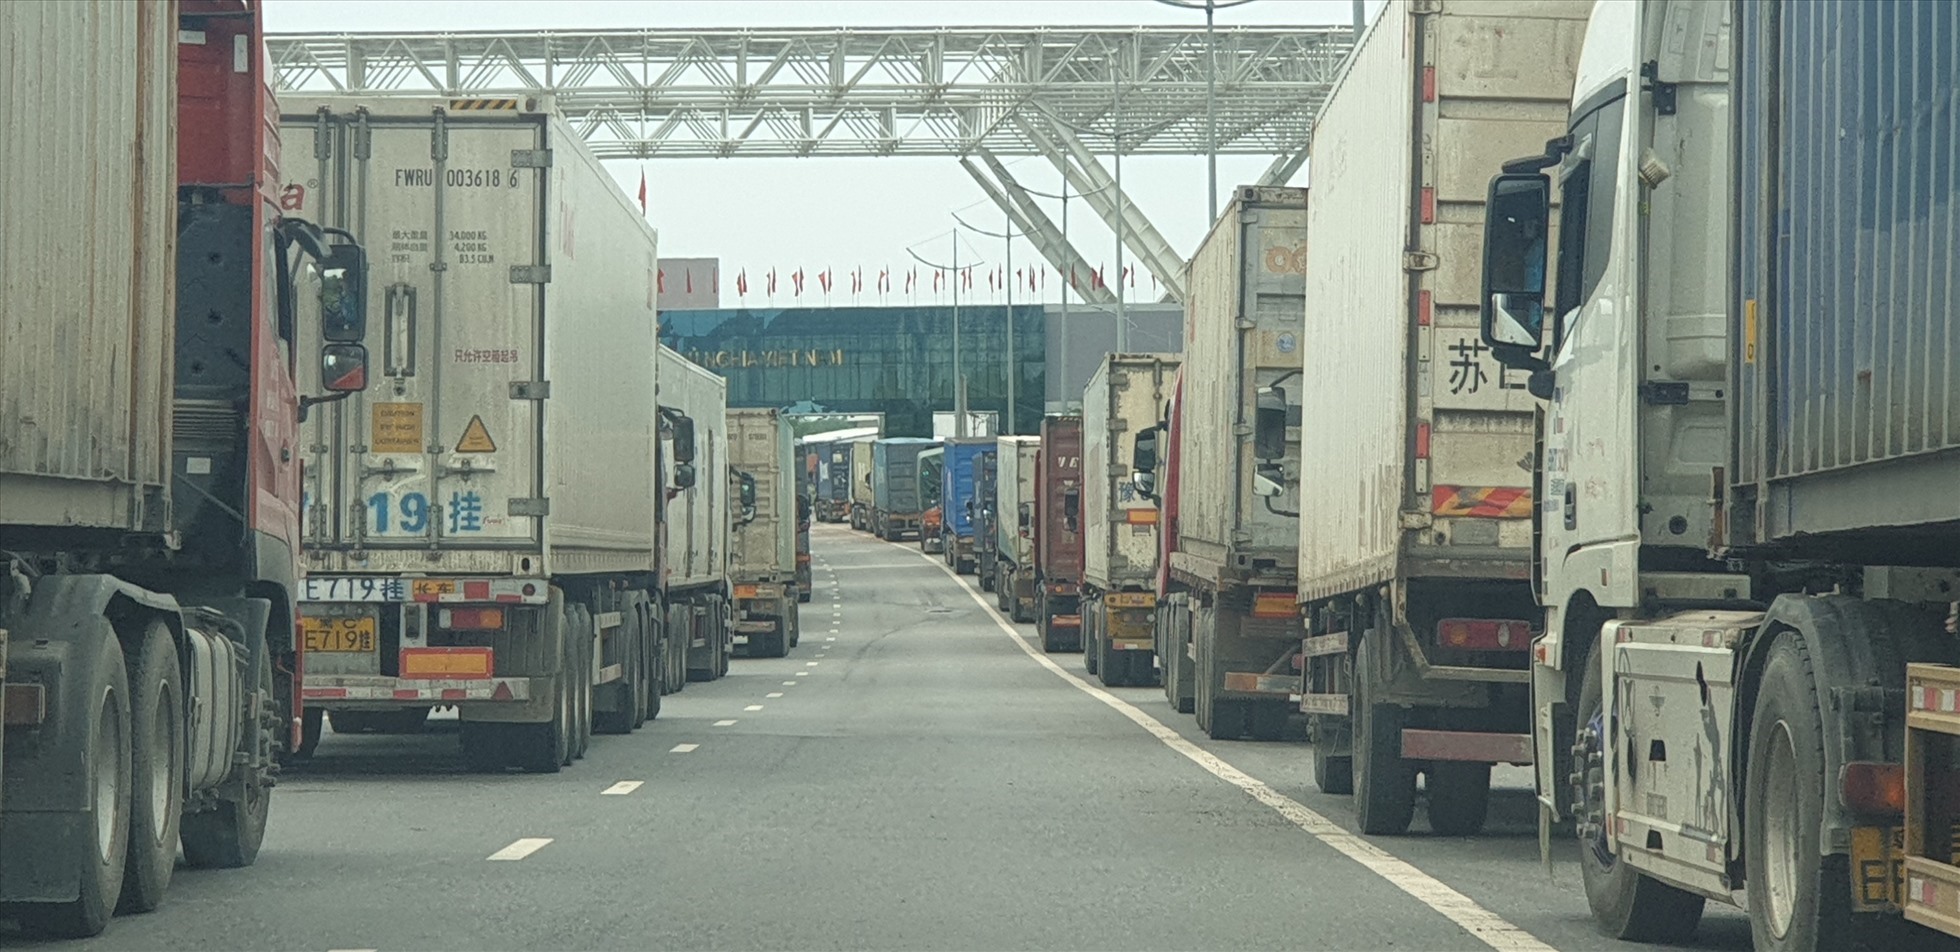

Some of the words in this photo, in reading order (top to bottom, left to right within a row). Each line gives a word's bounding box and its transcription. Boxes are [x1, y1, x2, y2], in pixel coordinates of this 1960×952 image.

[394, 168, 433, 187] FWRU
[446, 168, 500, 187] 003618
[509, 169, 517, 187] 6
